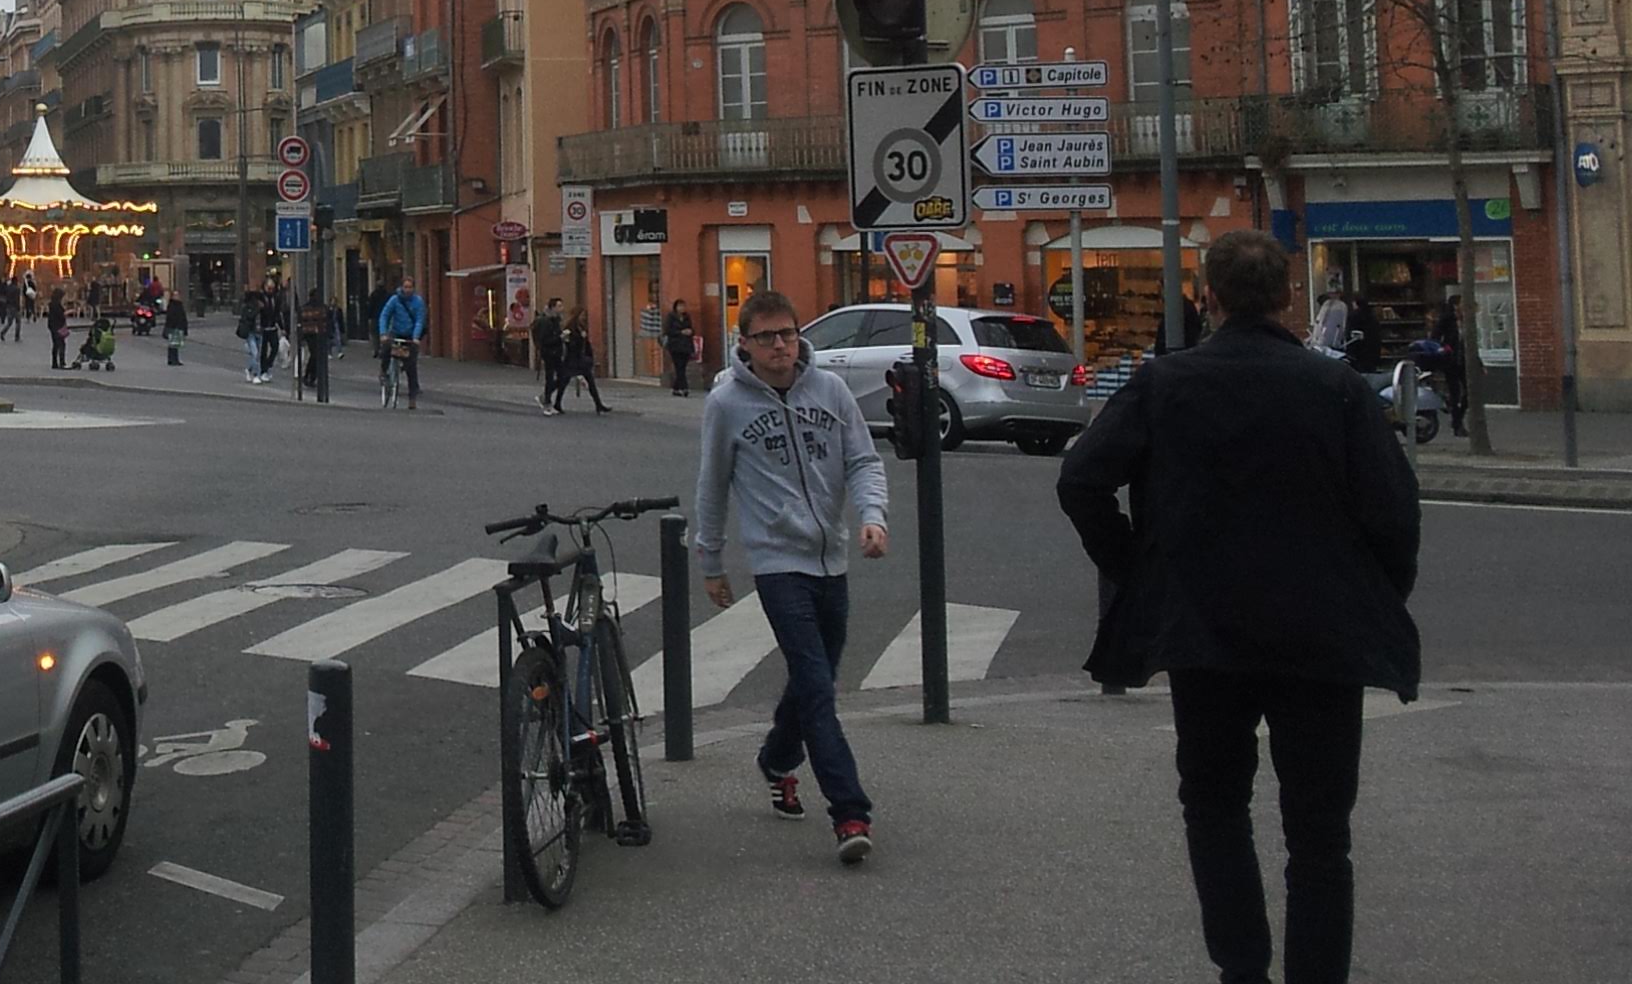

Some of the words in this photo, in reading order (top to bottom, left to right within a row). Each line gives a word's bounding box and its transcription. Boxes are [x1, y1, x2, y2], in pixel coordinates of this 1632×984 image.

[1047, 67, 1102, 84] Capitole
[857, 80, 885, 97] FIN
[906, 76, 953, 94] ZONE
[1006, 103, 1054, 116] Victor
[1061, 103, 1102, 119] Hugo
[1019, 139, 1052, 152] Jean
[1056, 138, 1104, 152] Jaurès
[887, 150, 928, 182] 30
[1019, 156, 1057, 169] Saint
[1062, 155, 1105, 168] Aubin
[1039, 191, 1105, 207] Georges
